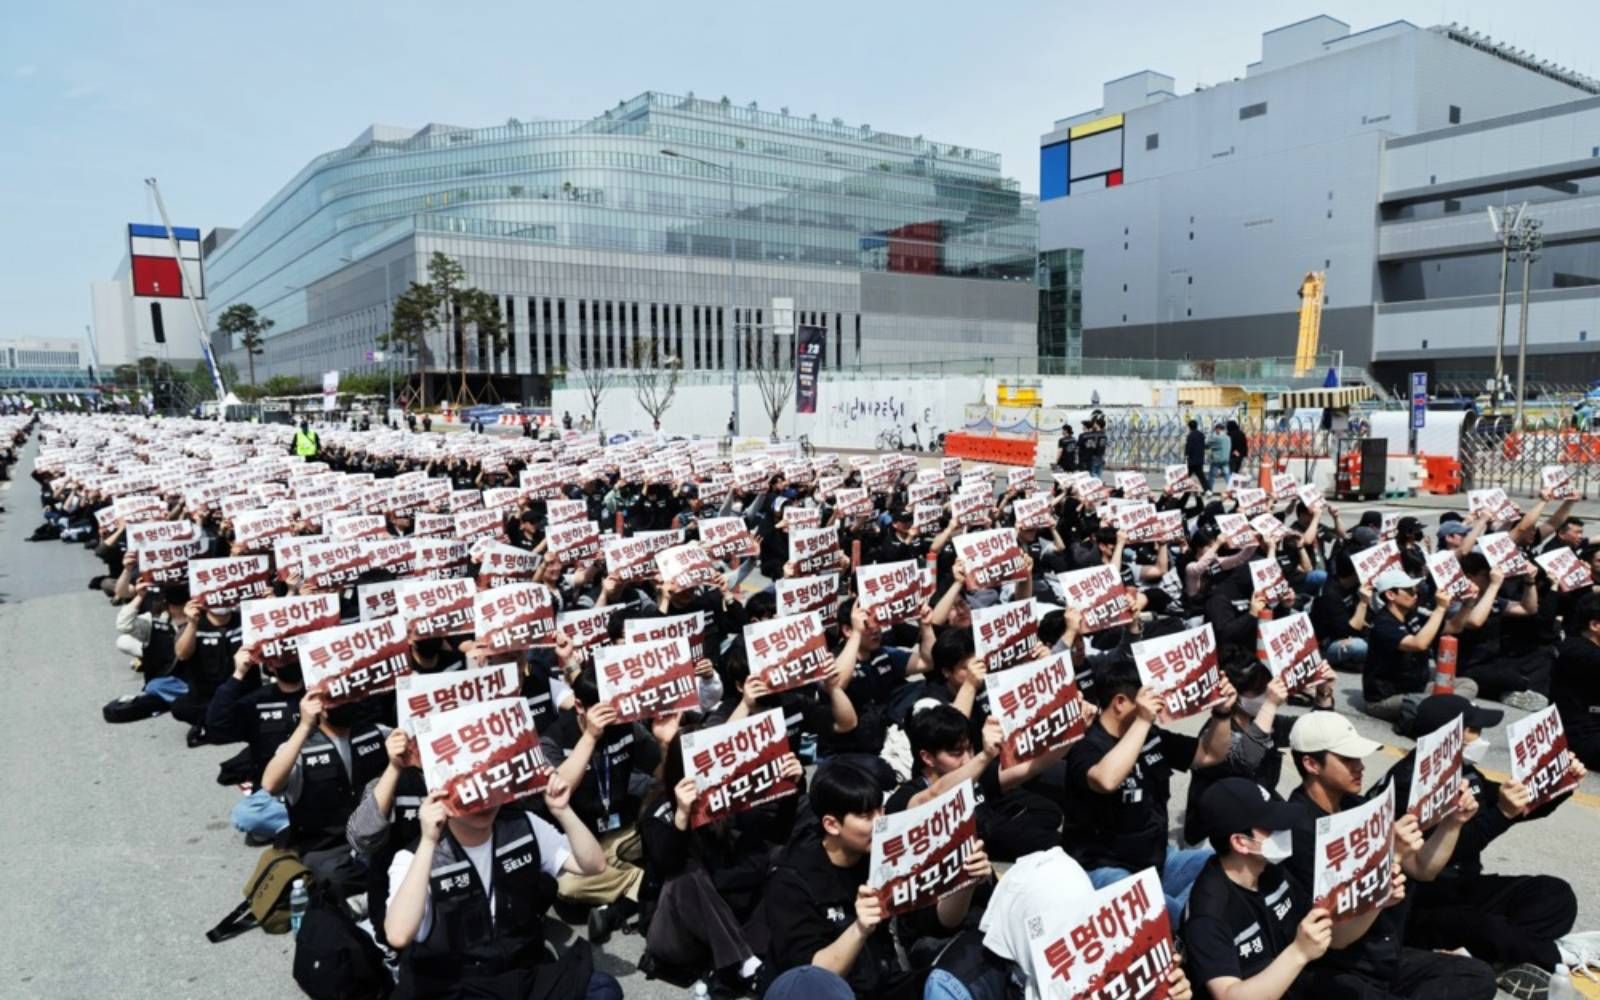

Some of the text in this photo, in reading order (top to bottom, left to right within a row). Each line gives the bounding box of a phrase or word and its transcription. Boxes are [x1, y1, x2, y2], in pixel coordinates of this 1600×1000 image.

[133, 523, 184, 543] 투명하게
[551, 524, 593, 545] 투명하게
[794, 528, 837, 553] 투명하게
[962, 530, 1014, 560] 투명하게
[196, 558, 260, 586] 투명하게
[308, 544, 361, 568] 투명하게
[975, 557, 1026, 584] 바꾸고!!!
[404, 582, 468, 611] 투명하게
[782, 578, 835, 608] 투명하게
[864, 565, 917, 597] 투명하게
[1068, 569, 1115, 601] 투명하게
[251, 597, 328, 632] 투명하게
[481, 587, 545, 622] 투명하게
[980, 602, 1032, 644] 투명하게
[309, 621, 394, 668] 투명하게
[491, 618, 555, 649] 바꾸고!!!
[752, 616, 815, 659] 투명하게
[989, 632, 1040, 671] 바꾸고!!!
[328, 653, 408, 698] 바꾸고!!!
[603, 641, 681, 686] 투명하게
[768, 645, 828, 687] 바꾸고!!!
[1145, 628, 1210, 682] 투명하게
[408, 668, 507, 718] 투명하게
[619, 674, 695, 717] 바꾸고!!!
[999, 656, 1068, 719] 투명하게
[431, 701, 528, 765] 투명하게
[692, 714, 776, 778] 투명하게
[1015, 695, 1082, 756] 바꾸고!!!
[1514, 709, 1560, 769] 투명하게
[1418, 722, 1461, 785] 투명하게
[456, 744, 545, 806] 바꾸고!!!
[882, 788, 967, 867] 투명하게
[439, 872, 469, 893] 투쟁
[503, 853, 533, 873] SELU
[1044, 879, 1150, 982] 투명하게
